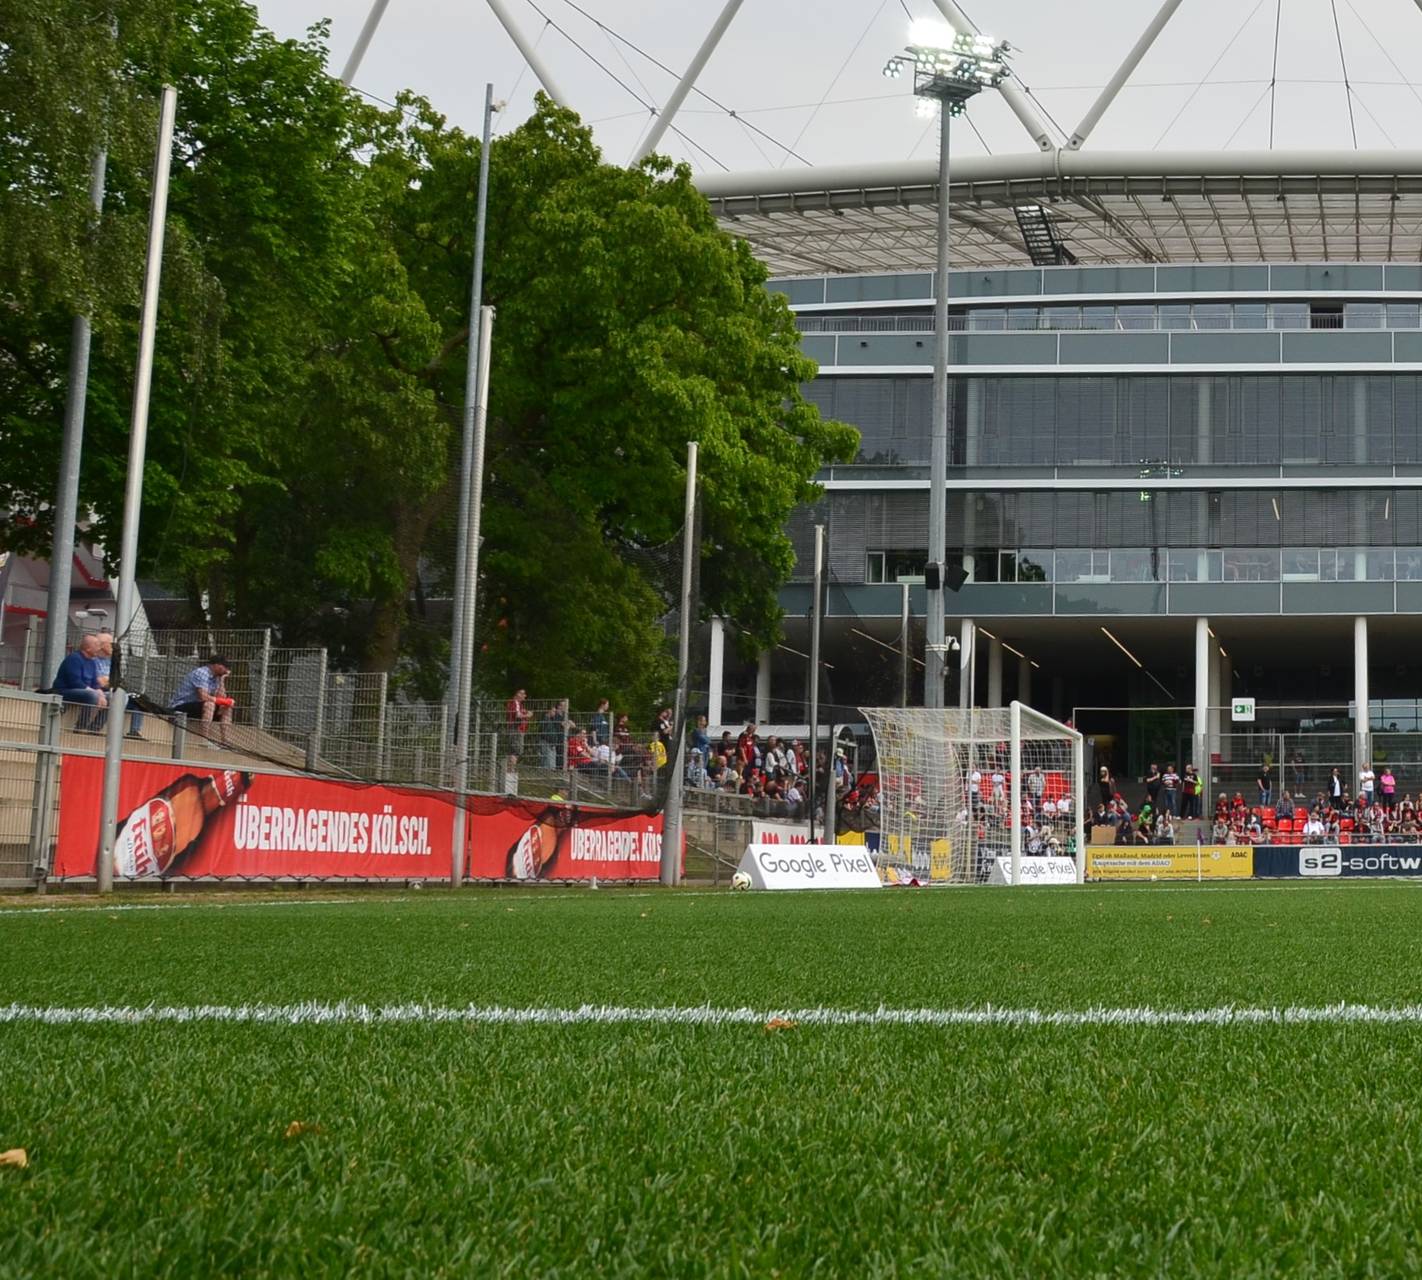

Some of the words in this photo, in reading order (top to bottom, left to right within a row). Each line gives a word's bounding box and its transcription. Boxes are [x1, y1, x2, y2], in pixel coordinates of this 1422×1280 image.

[234, 794, 369, 854] ÜBERRAGENDES
[370, 805, 432, 855] KÖLSCH.
[641, 825, 663, 862] KÖLS
[1230, 851, 1248, 859] ADAC
[759, 852, 827, 879] Google
[829, 853, 873, 873] Pixel
[1002, 860, 1046, 878] Gogle
[1049, 860, 1075, 875] Pixel
